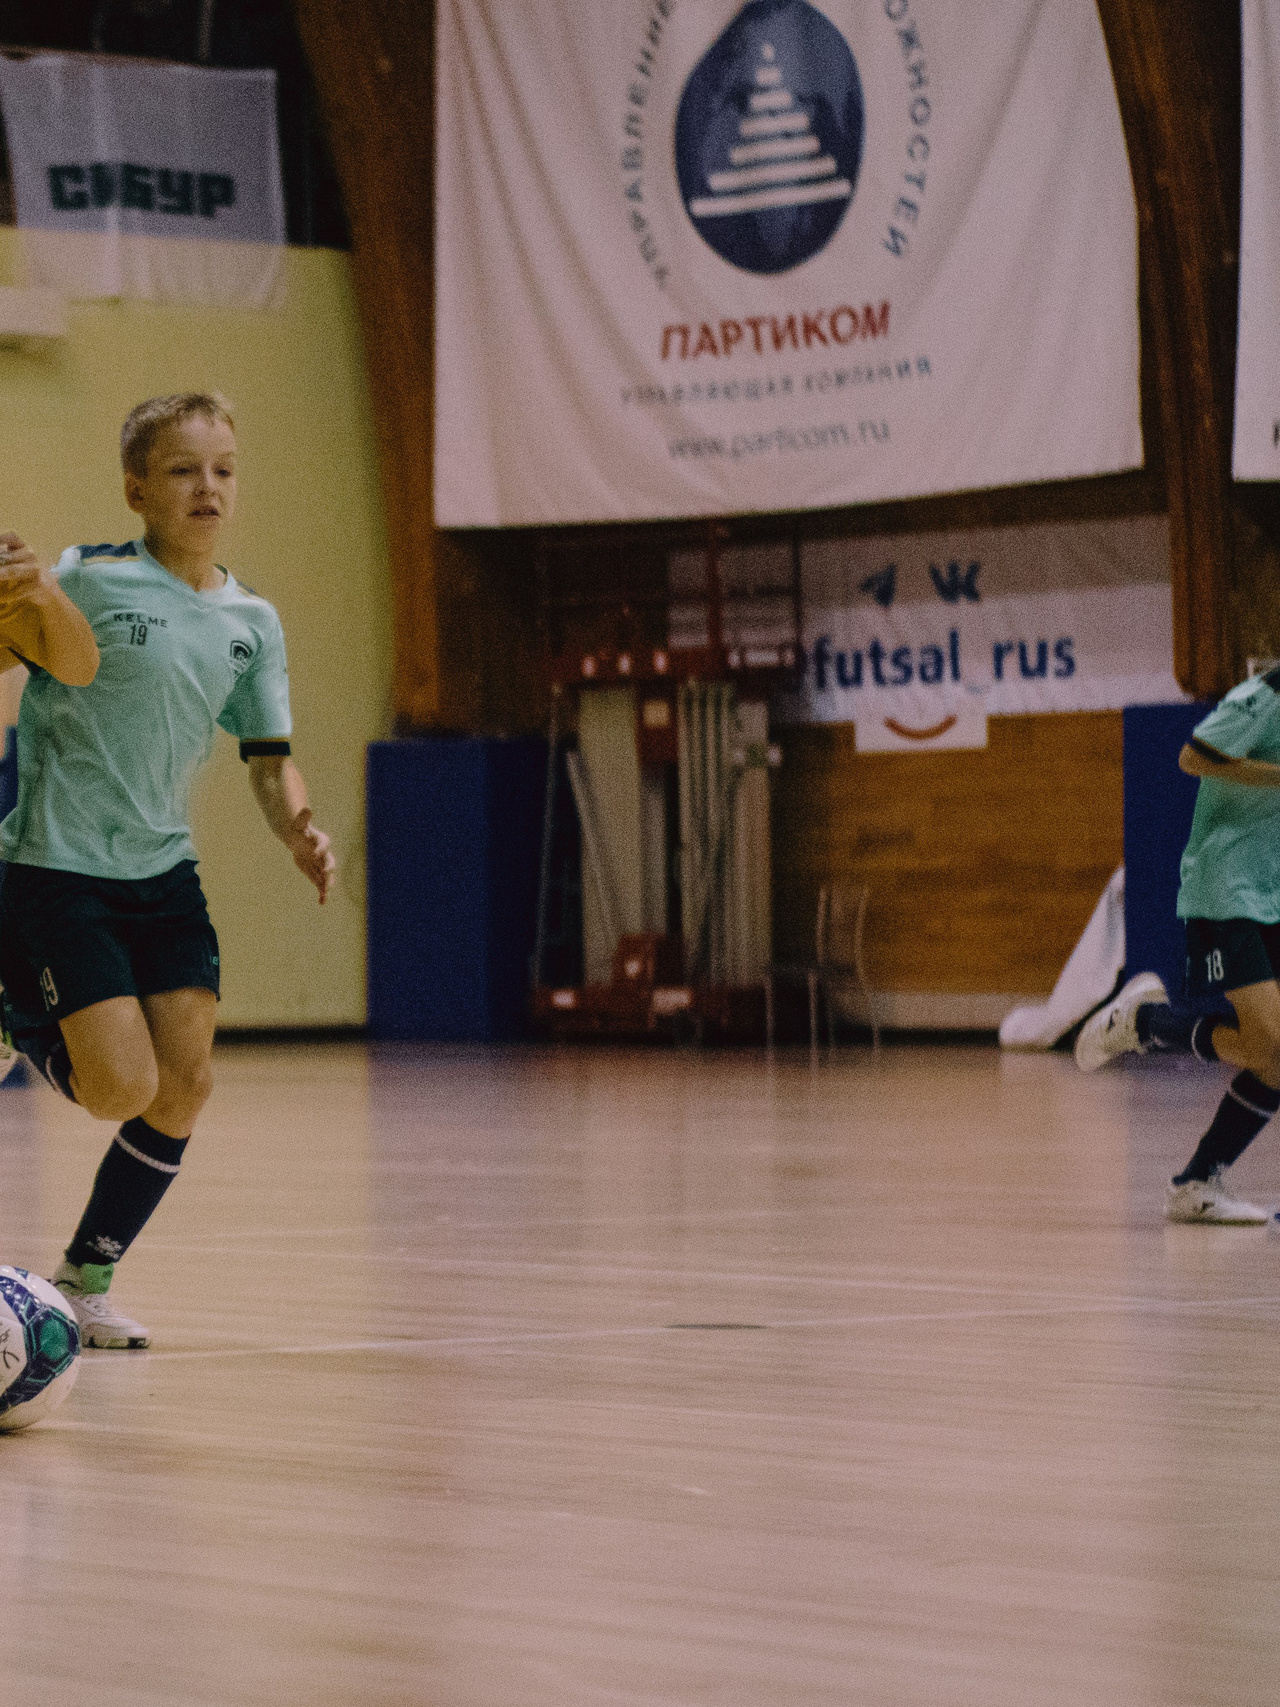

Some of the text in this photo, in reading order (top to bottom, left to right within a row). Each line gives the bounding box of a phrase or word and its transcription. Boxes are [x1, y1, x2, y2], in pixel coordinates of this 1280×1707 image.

[660, 301, 892, 362] ПАРТИКОМ
[113, 612, 168, 628] KELME
[129, 623, 149, 646] 19
[1204, 947, 1225, 983] 18
